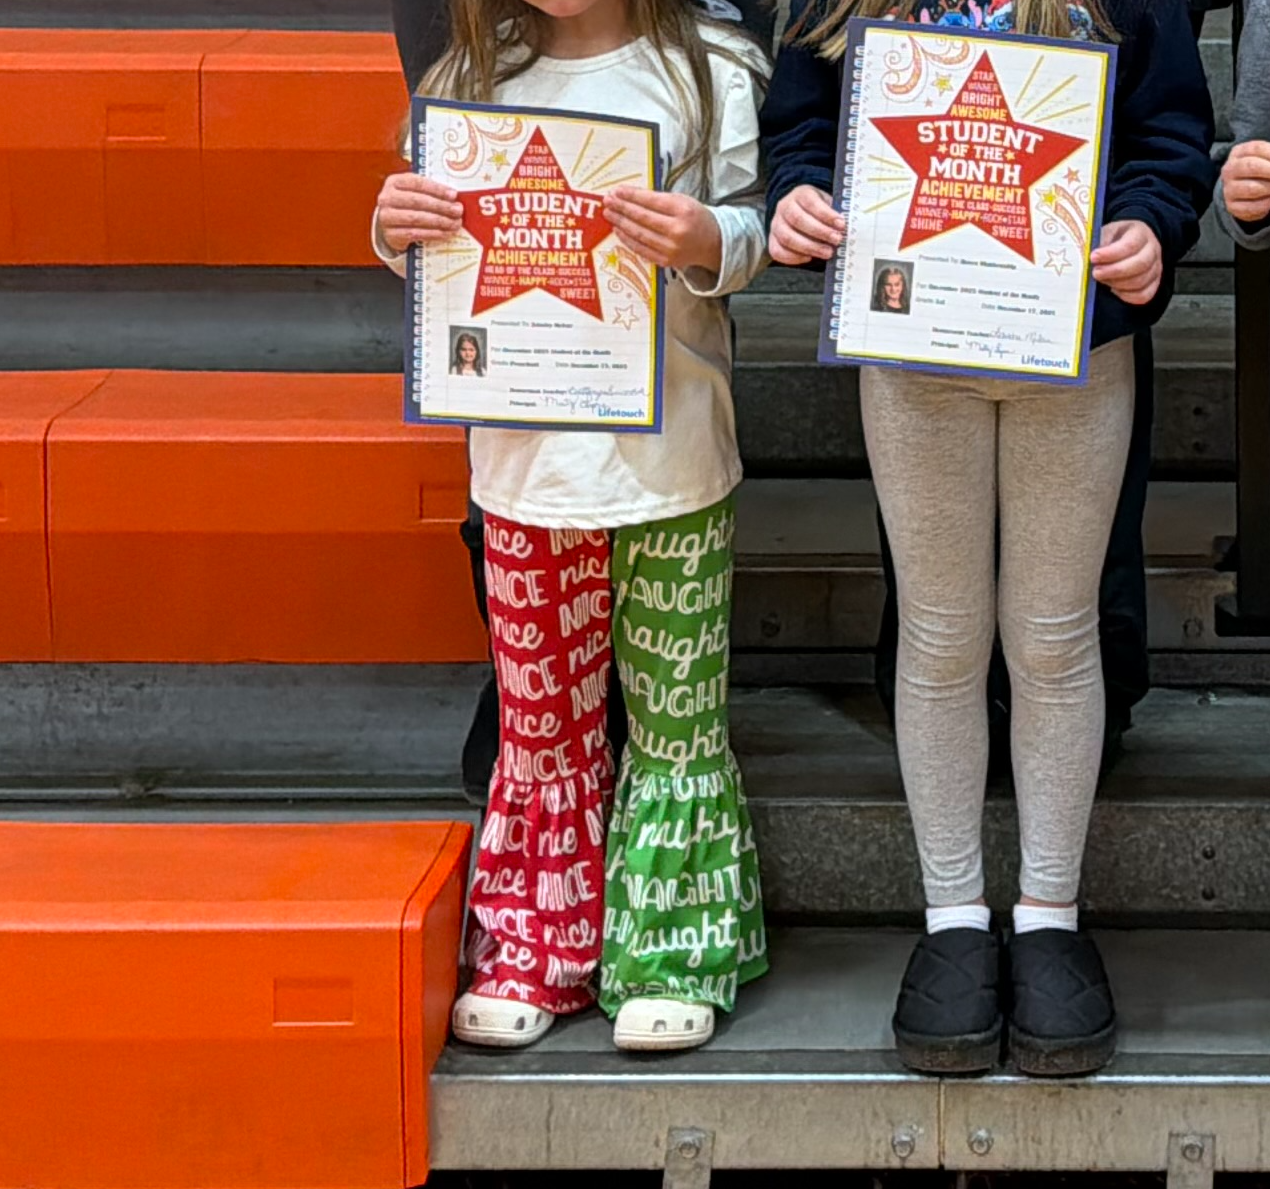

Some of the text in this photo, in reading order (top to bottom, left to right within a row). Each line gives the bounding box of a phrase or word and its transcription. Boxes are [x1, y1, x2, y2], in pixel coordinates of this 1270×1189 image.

[972, 70, 993, 81] STAR
[961, 91, 1002, 106] BRIGHT
[950, 104, 1007, 121] AWESOME
[917, 120, 1043, 153] STUDENT
[948, 143, 1004, 160] OF THE
[519, 164, 558, 176] BRIGHT
[928, 156, 1021, 185] MONTH
[509, 178, 564, 190] AWESOME
[919, 178, 1024, 203] ACHIEVEMENT
[478, 192, 601, 218] STUDENT
[511, 214, 564, 227] OF THE
[910, 217, 943, 230] SHINE
[493, 227, 582, 249] MONTH
[991, 225, 1029, 239] SWEET
[486, 249, 587, 266] ACHIEVEMENT
[480, 286, 512, 296] SHINE
[559, 288, 596, 299] SWEET
[1021, 355, 1069, 368] Lifetouch
[599, 408, 646, 418] Lifetouch
[504, 704, 563, 739] nice
[503, 738, 579, 784] NICE
[536, 860, 598, 912] NICE
[543, 917, 598, 949] nice
